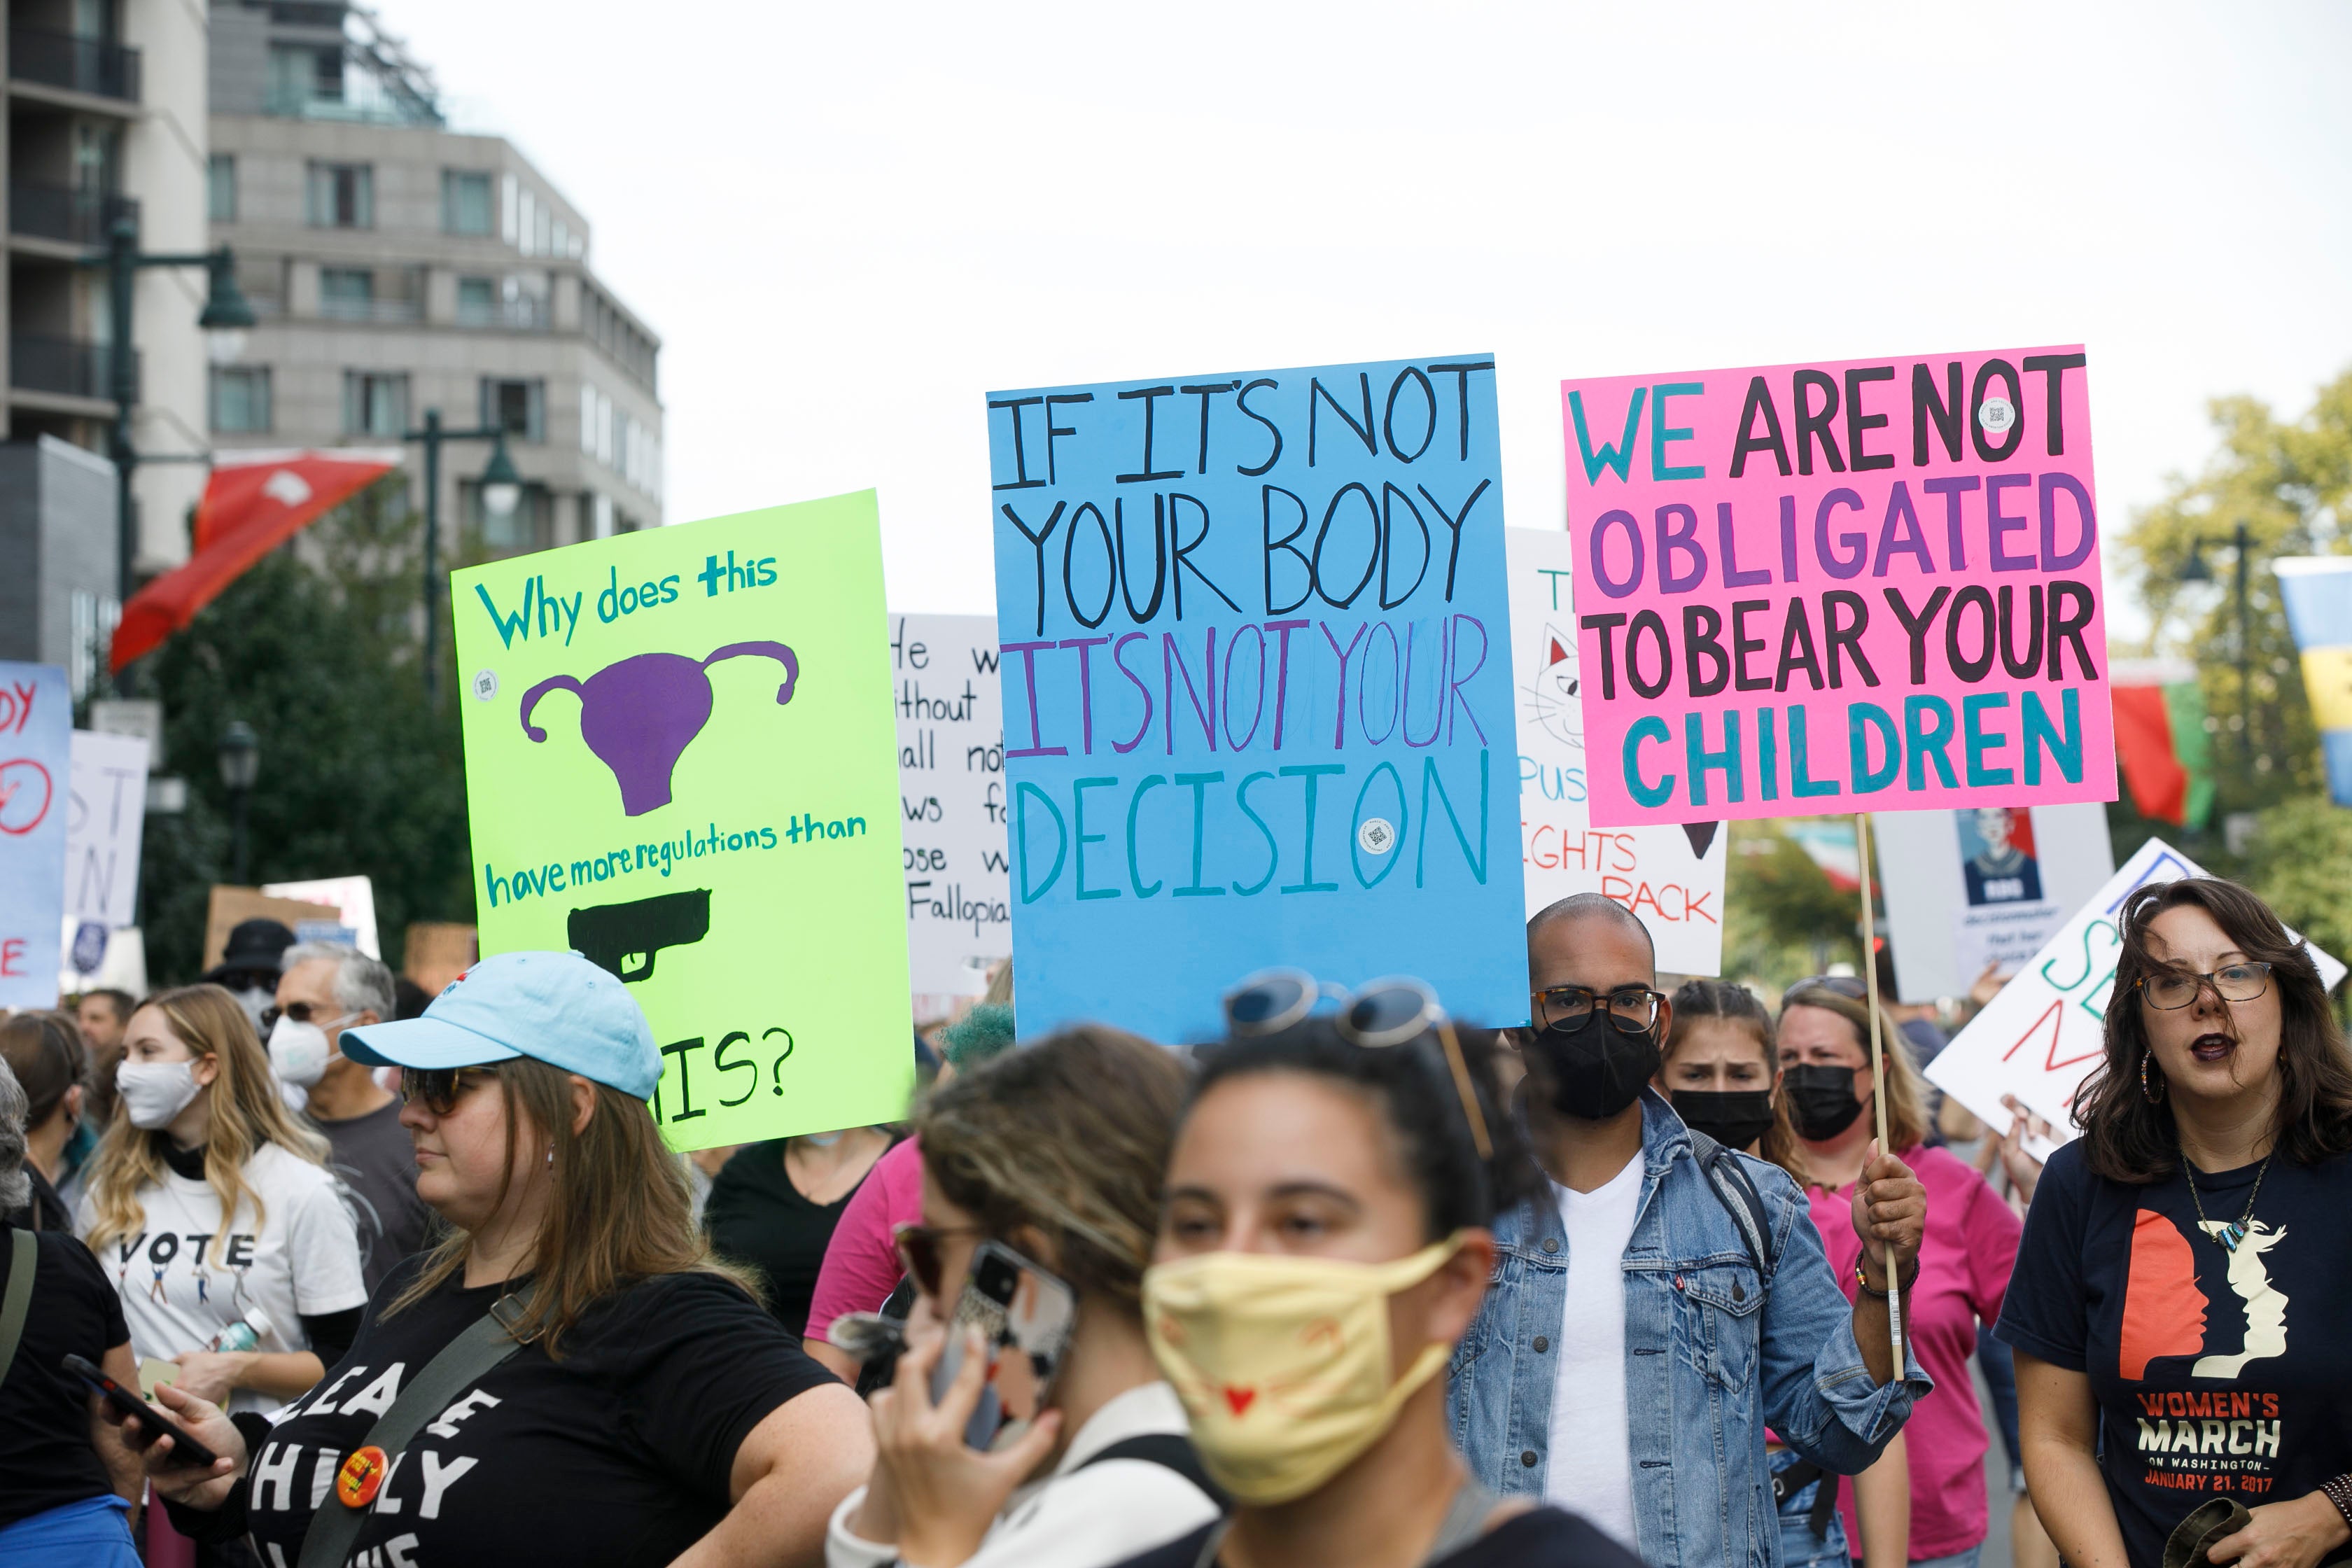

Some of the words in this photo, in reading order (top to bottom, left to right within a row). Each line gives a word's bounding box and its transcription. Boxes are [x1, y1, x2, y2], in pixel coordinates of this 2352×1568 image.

[988, 392, 1094, 490] IF
[1116, 378, 1283, 483] IT'S
[1308, 361, 1495, 468] NOT
[1568, 382, 1706, 486] WE
[1728, 365, 1896, 478] ARE
[1912, 353, 2087, 467] NOT
[1001, 492, 1242, 637] YOUR
[1263, 478, 1492, 616] BODY
[1590, 472, 2096, 599] OBLIGATED
[475, 575, 582, 650] Why
[597, 566, 680, 624] does
[697, 550, 778, 597] this
[1537, 569, 1575, 613] T
[971, 646, 1000, 675] w
[1000, 631, 1154, 758] IT'S
[1163, 619, 1310, 756] NOT
[1320, 613, 1489, 750] YOUR
[1581, 609, 1673, 700] TO
[1683, 589, 1880, 699] BEAR
[1883, 580, 2099, 685] YOUR
[898, 728, 934, 771] all
[1622, 687, 2084, 808] CHILDREN
[902, 795, 943, 822] ws
[1015, 748, 1489, 904] DECISION
[1520, 820, 1636, 872] GHTS
[485, 862, 566, 908] have
[570, 848, 633, 886] more
[636, 822, 778, 877] regulations
[785, 813, 867, 844] than
[981, 850, 1009, 874] w
[654, 1027, 794, 1126] IS?
[119, 1231, 256, 1267] VOTE
[2136, 1391, 2279, 1418] WOMEN'S
[2136, 1417, 2281, 1458] MARCH
[2144, 1468, 2207, 1490] JANUARY
[2241, 1474, 2273, 1493] 2017
